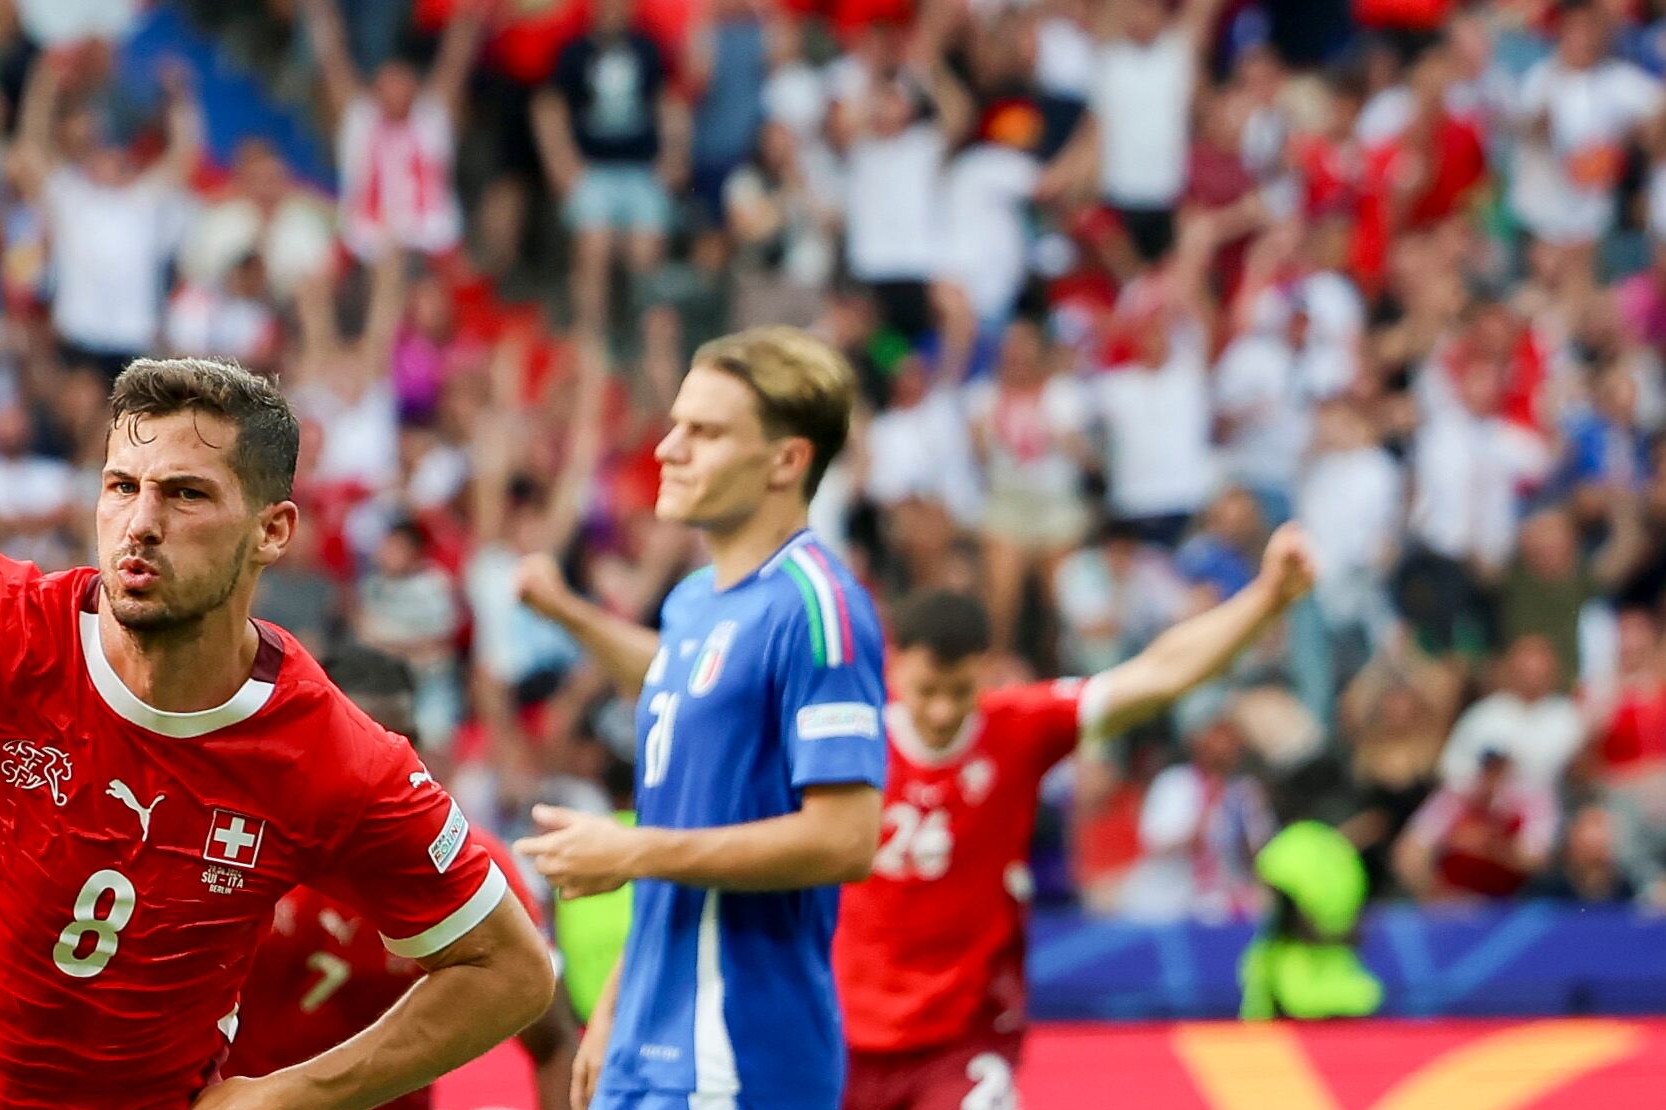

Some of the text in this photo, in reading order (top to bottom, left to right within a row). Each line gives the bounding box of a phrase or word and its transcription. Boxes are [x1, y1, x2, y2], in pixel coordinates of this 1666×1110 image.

[201, 871, 218, 884] SUI
[227, 876, 244, 889] ITA
[208, 884, 232, 895] BERLIN
[53, 868, 136, 978] 8
[300, 952, 352, 1014] 7
